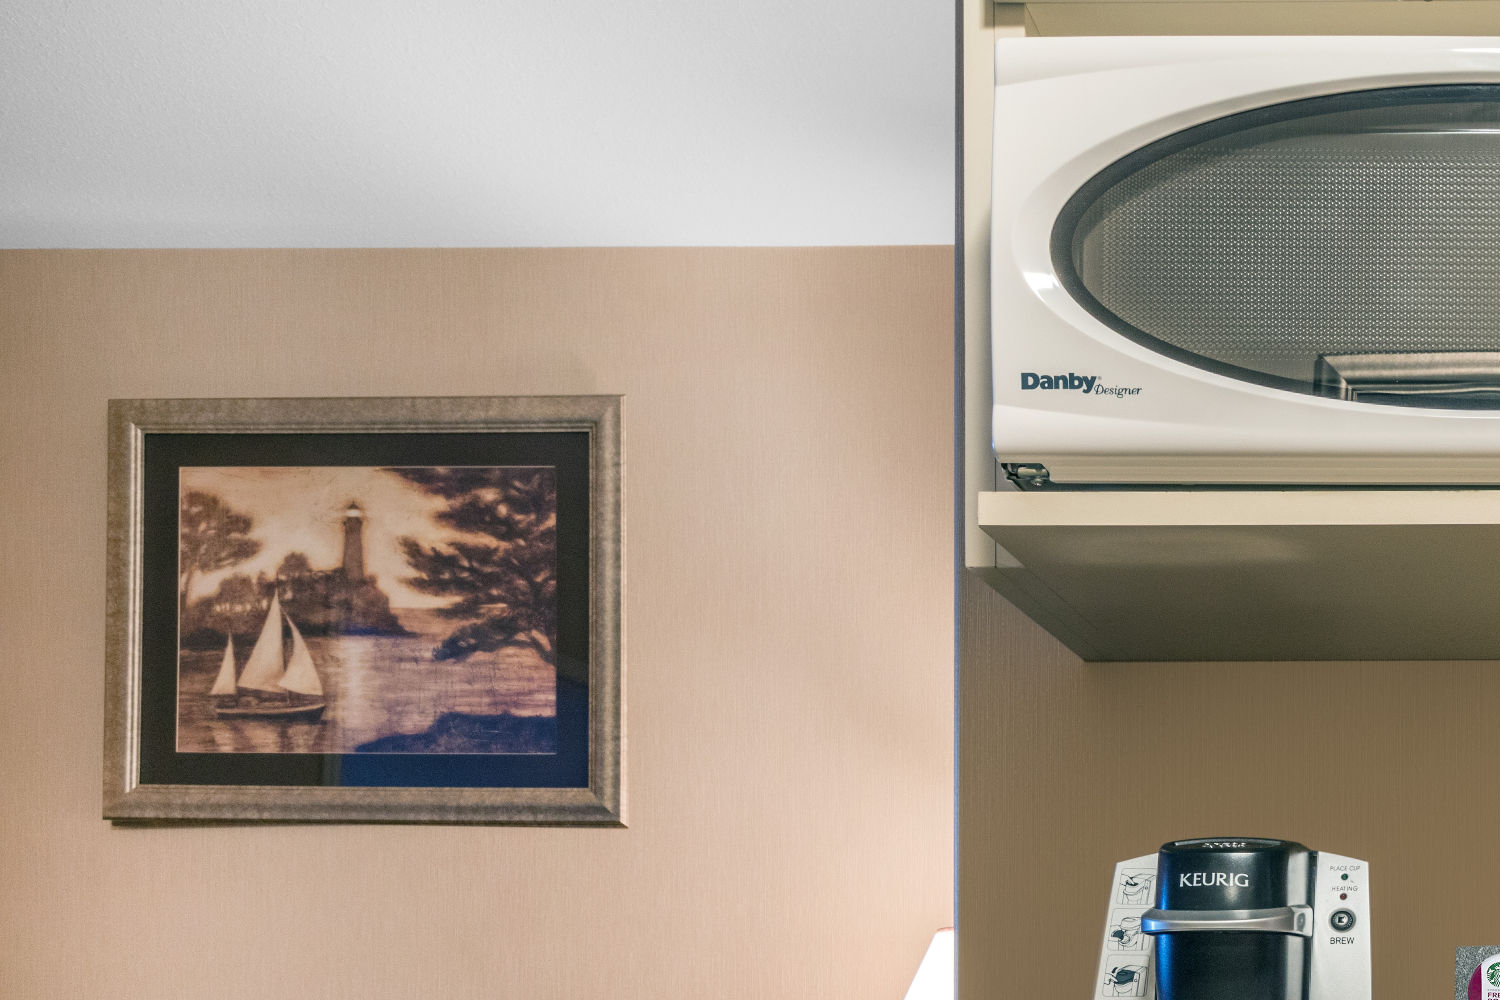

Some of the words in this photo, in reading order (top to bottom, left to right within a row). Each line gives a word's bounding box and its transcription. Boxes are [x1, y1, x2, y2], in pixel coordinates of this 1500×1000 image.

[1021, 373, 1097, 394] Danby
[1094, 384, 1142, 398] Designer
[1180, 872, 1249, 887] KEURIG
